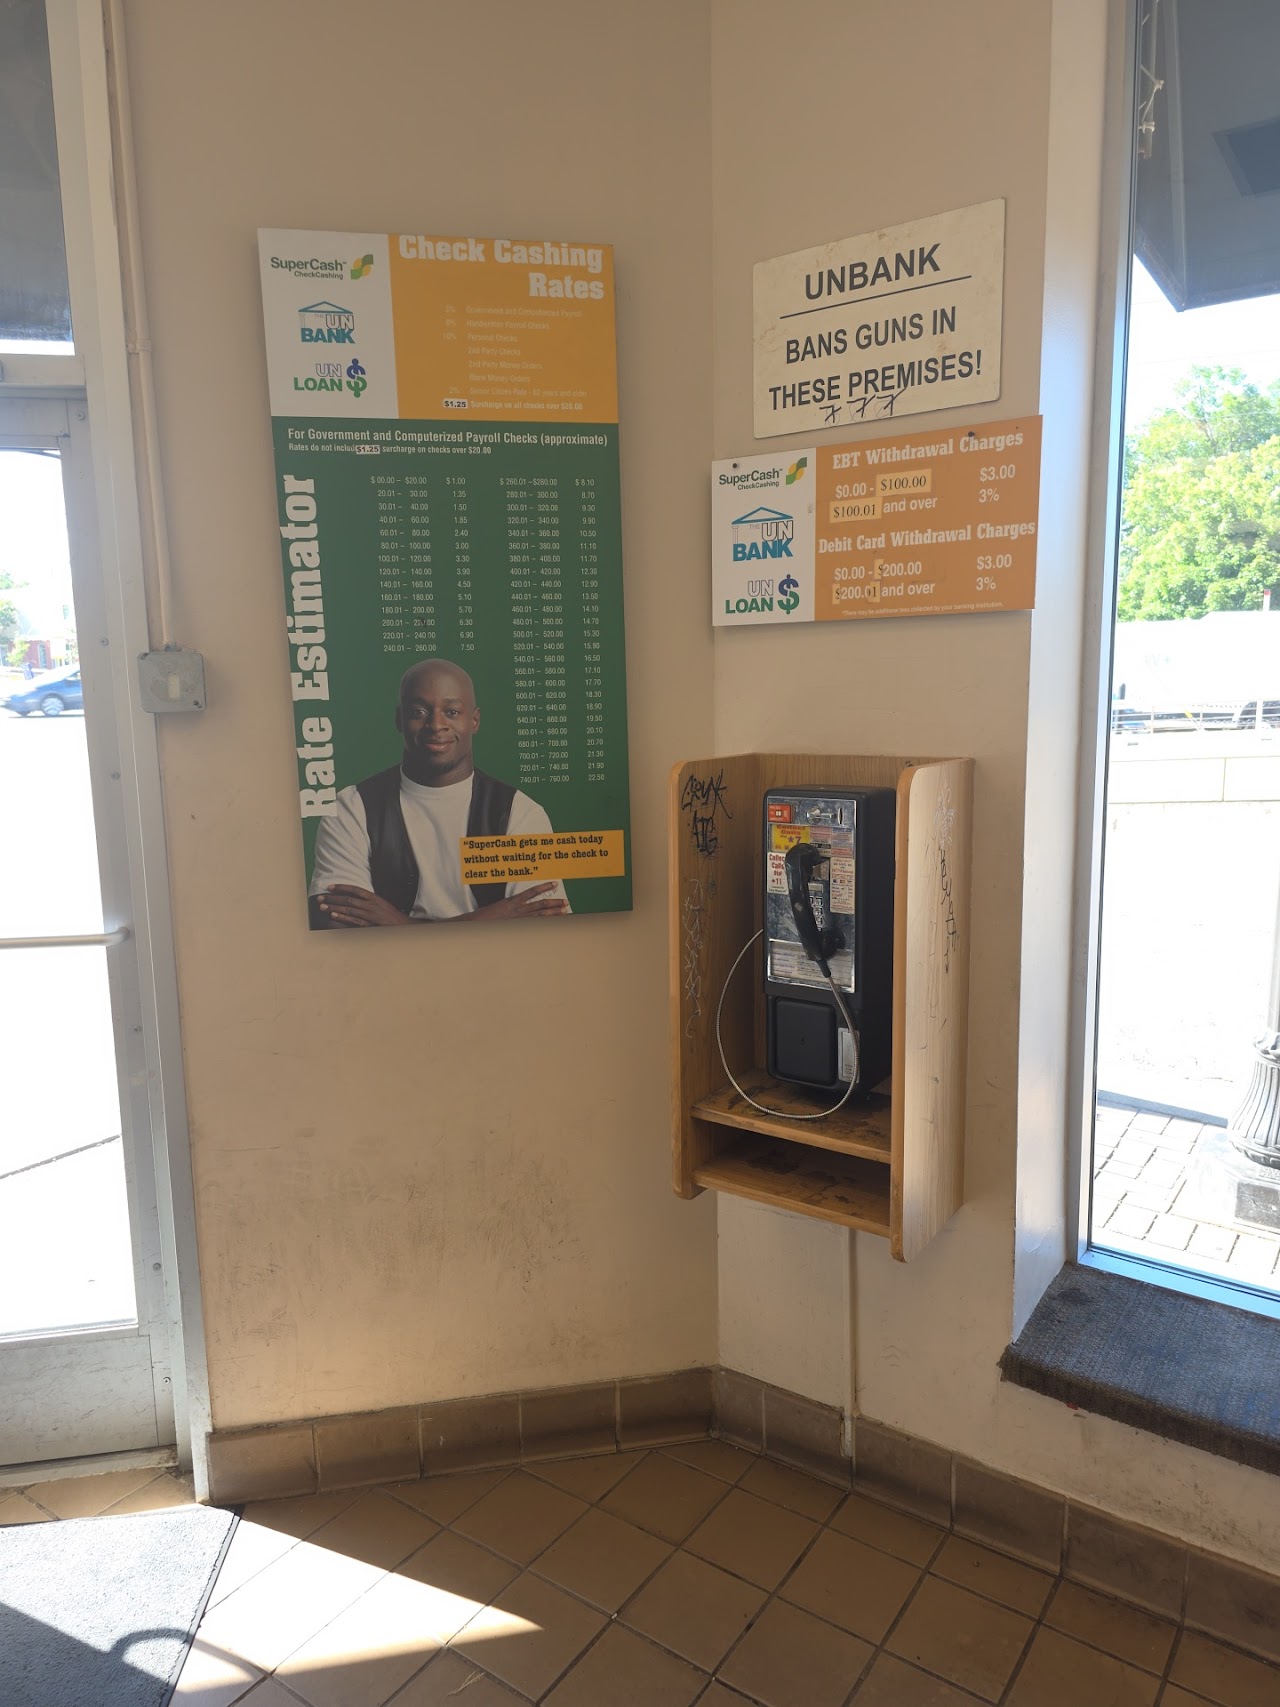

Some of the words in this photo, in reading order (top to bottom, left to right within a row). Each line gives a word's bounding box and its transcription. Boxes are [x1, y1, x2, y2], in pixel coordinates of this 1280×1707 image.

[398, 234, 486, 262] Check
[493, 239, 603, 274] Cashing
[270, 256, 343, 272] SuperCash
[805, 243, 941, 300] UNBANK
[294, 271, 344, 280] CheckCashing
[528, 272, 605, 300] Rates
[325, 314, 355, 331] UN
[300, 327, 356, 344] BANK
[786, 328, 848, 365] BANS
[855, 312, 924, 350] GUNS
[932, 305, 956, 336] IN
[315, 363, 342, 378] UN
[482, 361, 498, 370] Party
[499, 361, 520, 370] Money
[293, 377, 343, 392] LOAN
[769, 375, 841, 411] THESE
[849, 349, 982, 397] PREMISES!
[444, 400, 467, 408] $1.25
[288, 428, 305, 440] For
[308, 429, 370, 441] Government
[373, 430, 391, 441] and
[394, 430, 463, 443] Computerized
[466, 432, 500, 445] Payroll
[503, 432, 538, 444] Checks
[540, 433, 608, 447] (approximate)
[288, 443, 309, 451] Rates
[321, 444, 332, 452] not
[382, 446, 416, 454] surcharge
[468, 446, 492, 454] $20.00
[832, 451, 861, 470] EBT
[865, 438, 954, 465] Withdrawal
[959, 432, 1024, 453] Charges
[719, 468, 780, 487] SuperCash
[737, 480, 780, 491] CheckCashing
[835, 482, 867, 499] $0.00
[880, 475, 927, 492] $100.00
[979, 464, 1016, 482] $3.00
[409, 490, 428, 498] 30.00
[453, 490, 467, 498] 1.35
[833, 503, 876, 519] $100.01
[883, 498, 906, 514] and
[909, 497, 938, 510] over
[979, 487, 1000, 503] 3%
[379, 516, 397, 524] 40.01
[411, 516, 430, 524] 60.00
[454, 516, 468, 524] 1.85
[379, 529, 398, 537] 60.01
[411, 529, 430, 537] 80.00
[454, 529, 469, 537] 2.40
[761, 520, 793, 542] UN
[818, 537, 852, 554] Debit
[856, 533, 885, 551] Card
[890, 525, 971, 547] Withdrawal
[977, 522, 1036, 540] Charges
[732, 538, 793, 562] BANK
[378, 555, 399, 563] 100.01
[410, 555, 431, 563] 120.00
[455, 555, 470, 563] 3.30
[834, 565, 865, 581] $0.00
[877, 561, 922, 577] $200.00
[977, 553, 1012, 571] $3.00
[280, 474, 330, 701] Estimator
[748, 579, 774, 597] UN
[881, 582, 904, 597] and
[907, 583, 935, 595] over
[976, 576, 996, 591] 3%
[725, 597, 773, 614] LOAN
[414, 631, 436, 639] 240.00
[459, 631, 474, 639] 6.90
[543, 630, 564, 638] 520.00
[519, 752, 539, 760] 700.01
[548, 751, 569, 759] 720.00
[297, 716, 338, 818] Rate
[588, 773, 605, 781] 22.50
[519, 838, 538, 848] gets
[556, 836, 576, 844] cash
[579, 835, 603, 845] today
[464, 854, 499, 864] without
[502, 852, 536, 862] waiting
[538, 851, 552, 860] for
[554, 851, 569, 859] the
[571, 849, 597, 858] check
[599, 849, 609, 857] to
[464, 869, 488, 879] clear
[490, 868, 505, 877] the
